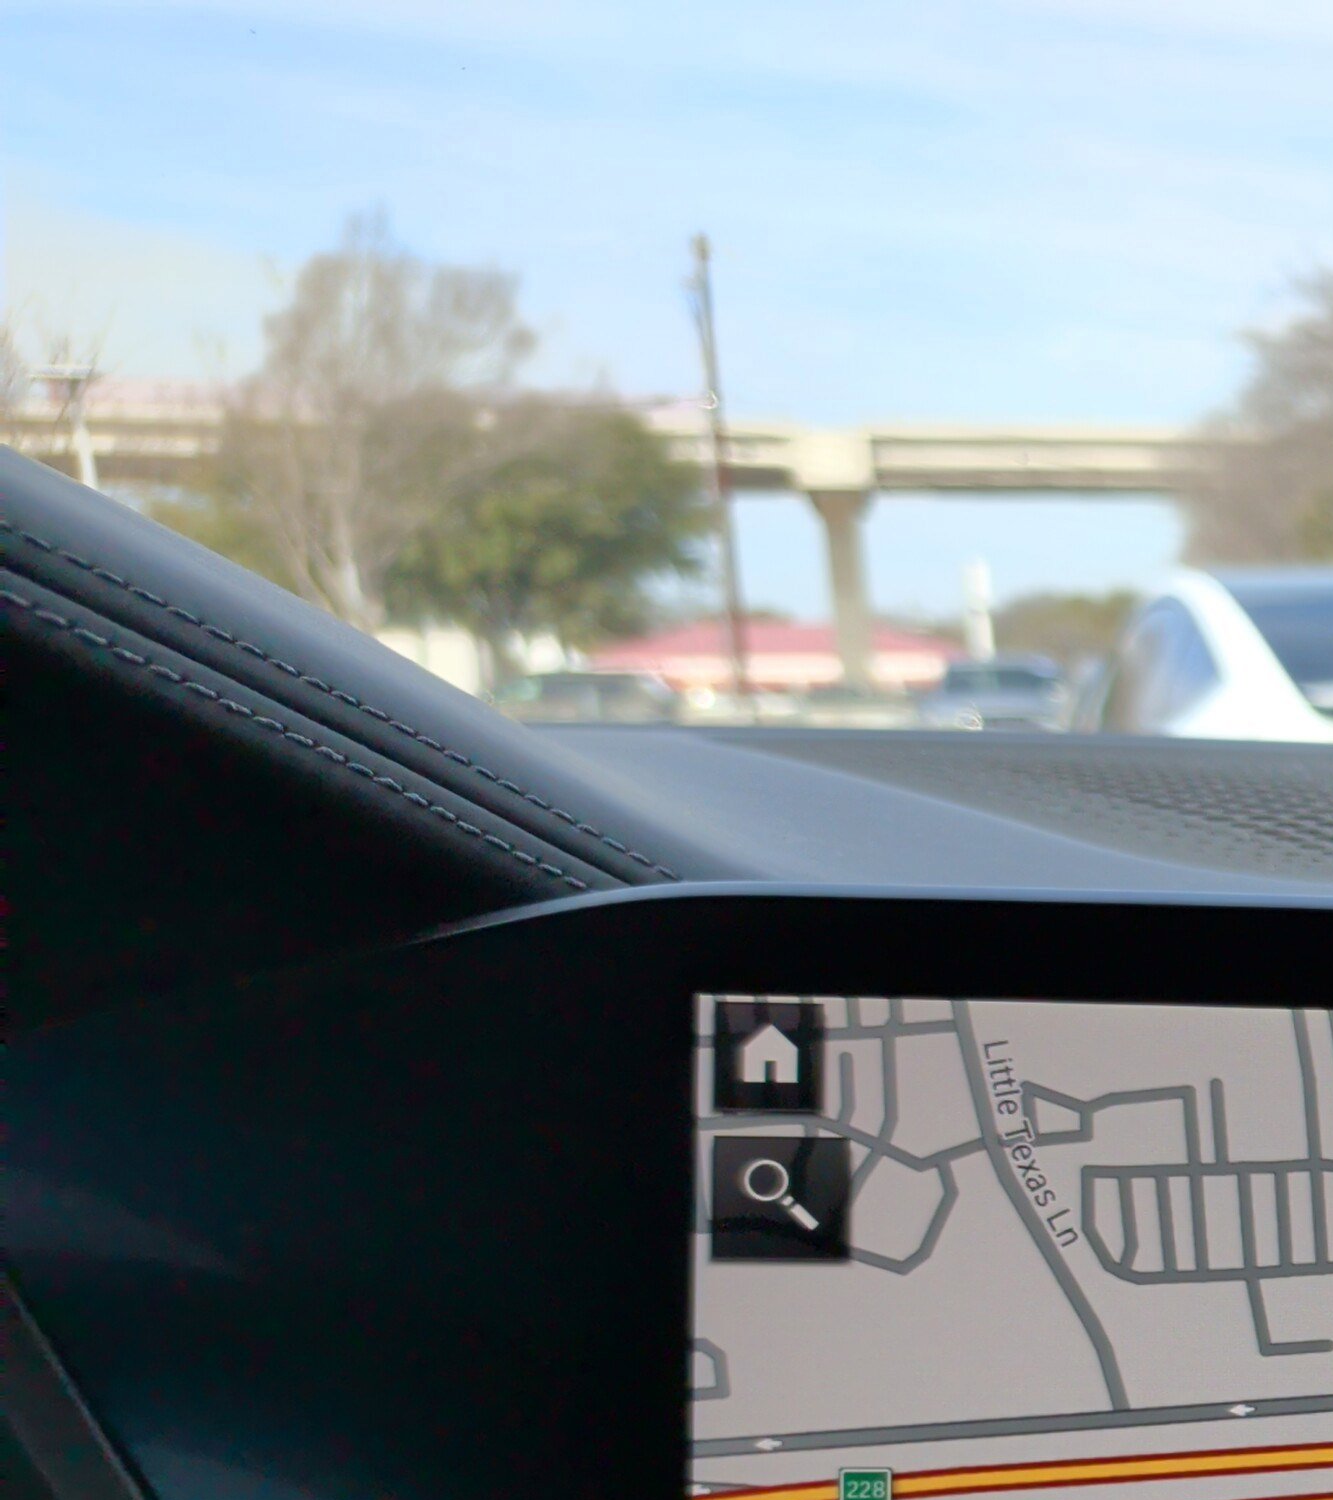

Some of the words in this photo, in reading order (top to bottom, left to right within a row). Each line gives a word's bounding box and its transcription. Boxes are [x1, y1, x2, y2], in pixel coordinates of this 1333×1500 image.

[983, 1039, 1021, 1115] Little
[1004, 1119, 1057, 1208] Texas
[1046, 1208, 1080, 1248] Ln
[845, 1479, 886, 1500] 228
